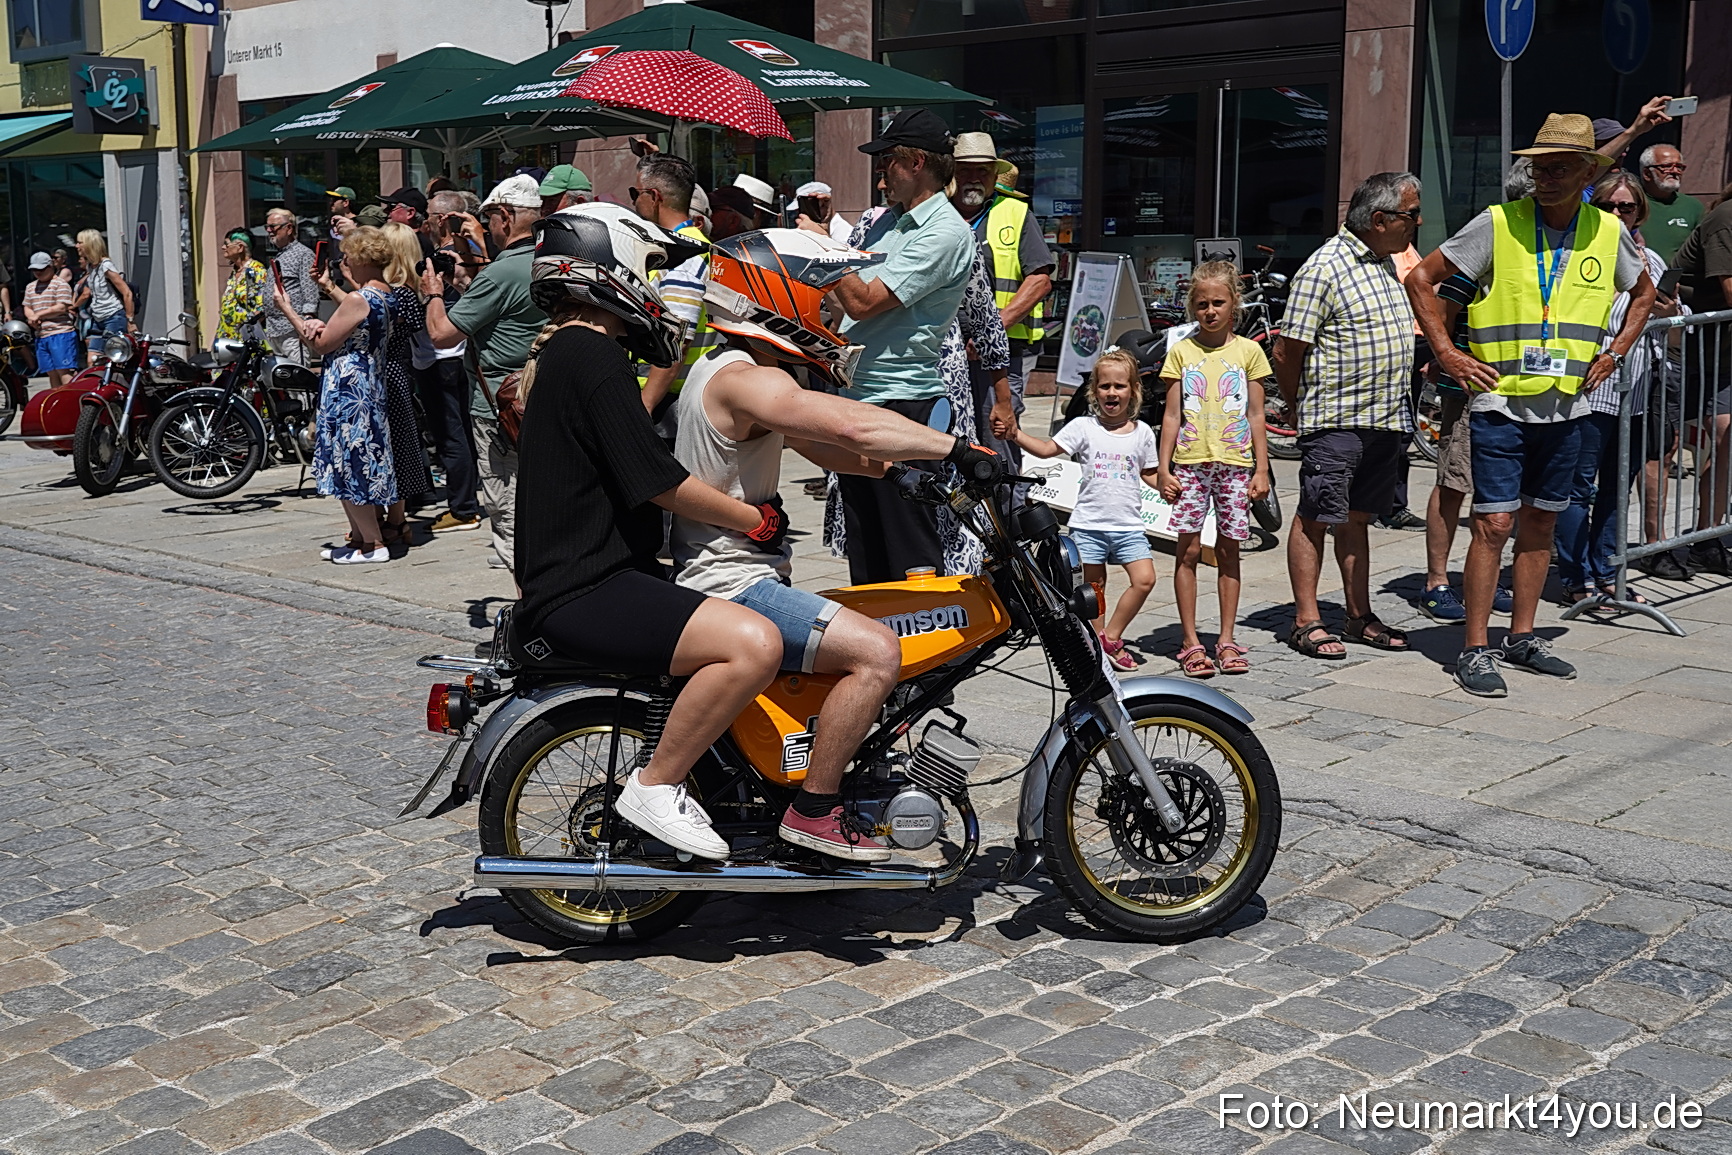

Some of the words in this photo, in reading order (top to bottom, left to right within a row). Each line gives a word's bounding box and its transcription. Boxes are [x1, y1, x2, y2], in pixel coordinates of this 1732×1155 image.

[227, 49, 252, 64] Unterer
[252, 45, 273, 61] Markt
[274, 43, 283, 57] 15
[103, 77, 129, 110] G2
[511, 78, 577, 93] Neumarkt
[482, 87, 566, 106] Lammsbr
[1040, 127, 1060, 137] Love
[1062, 125, 1069, 134] is
[1071, 123, 1085, 133] lov
[749, 306, 841, 361] 100%
[1094, 450, 1107, 460] An
[876, 604, 970, 638] imson
[530, 644, 545, 655] IFA
